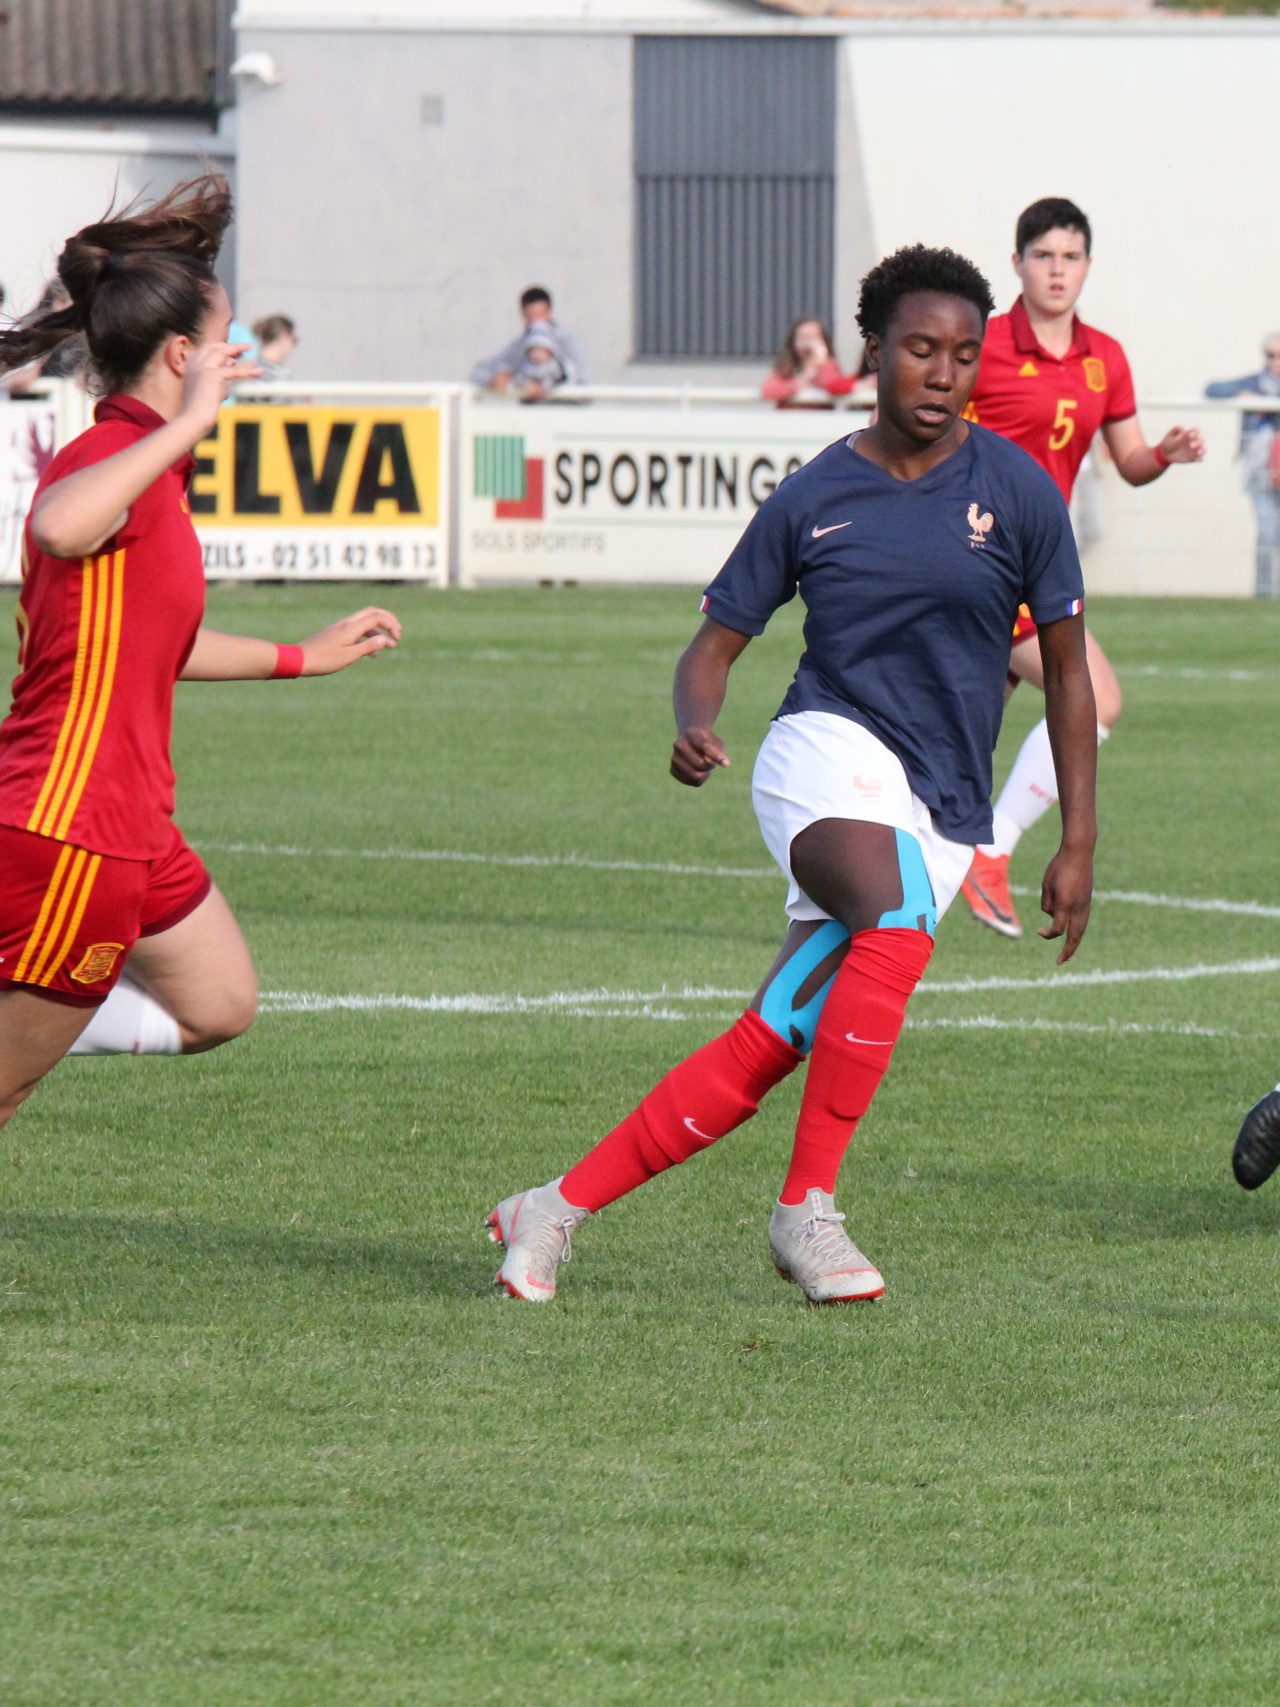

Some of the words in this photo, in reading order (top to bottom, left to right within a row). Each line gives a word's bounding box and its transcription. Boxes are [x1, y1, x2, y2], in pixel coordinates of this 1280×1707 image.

[1049, 399, 1078, 451] 5
[472, 531, 514, 550] SOLS
[273, 543, 298, 567] 02
[309, 543, 331, 567] 51
[343, 543, 366, 567] 42
[376, 543, 401, 567] 98
[413, 543, 435, 567] 13
